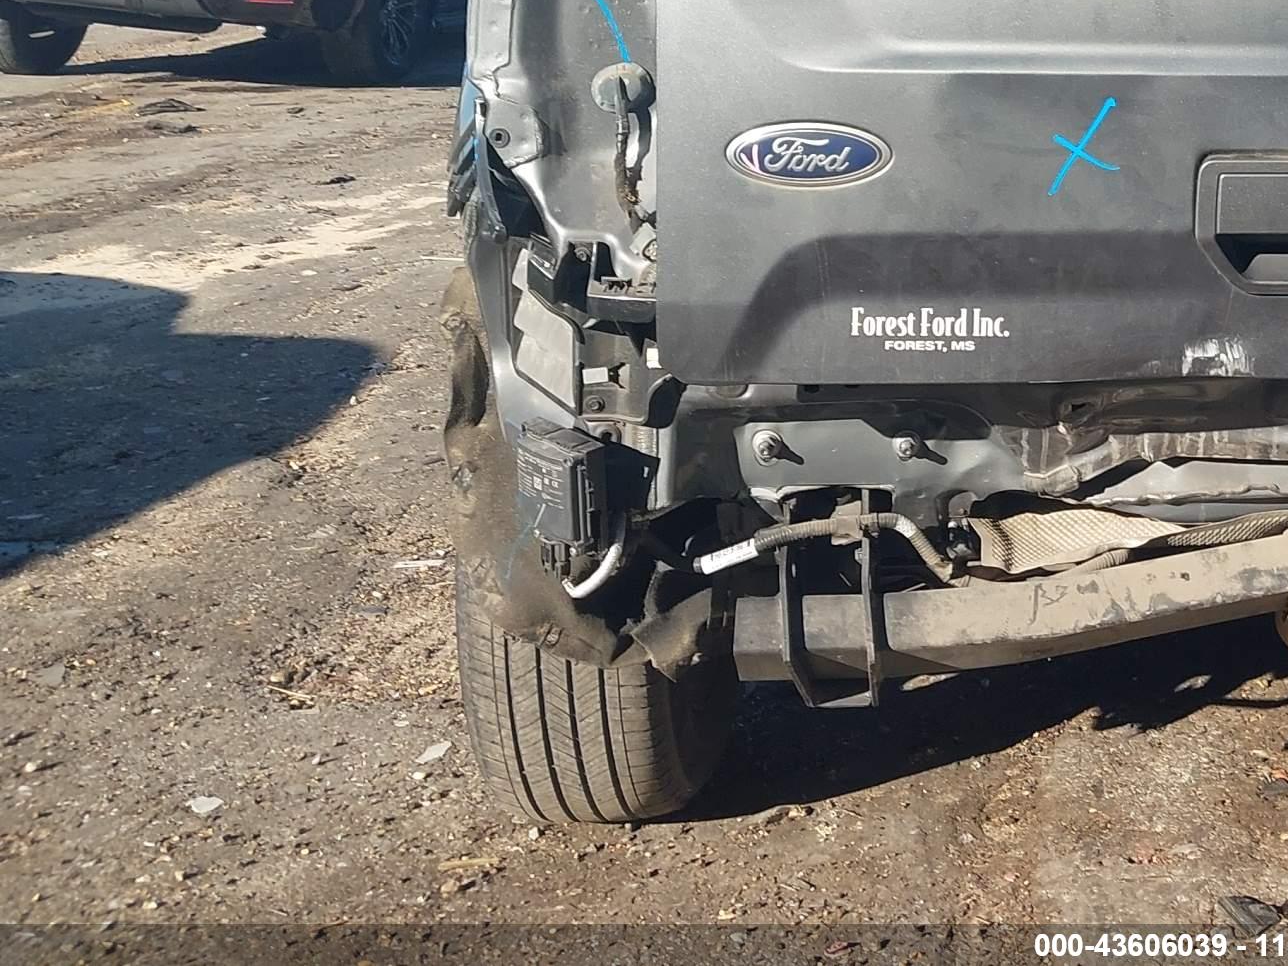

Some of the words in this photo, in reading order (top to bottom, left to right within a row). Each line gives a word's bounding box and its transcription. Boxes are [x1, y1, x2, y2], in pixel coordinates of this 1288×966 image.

[763, 135, 853, 174] Ford
[850, 306, 918, 338] Forest
[919, 307, 968, 338] Ford
[971, 307, 1011, 338] Inc.
[884, 340, 948, 354] FOREST,
[950, 340, 976, 352] MS
